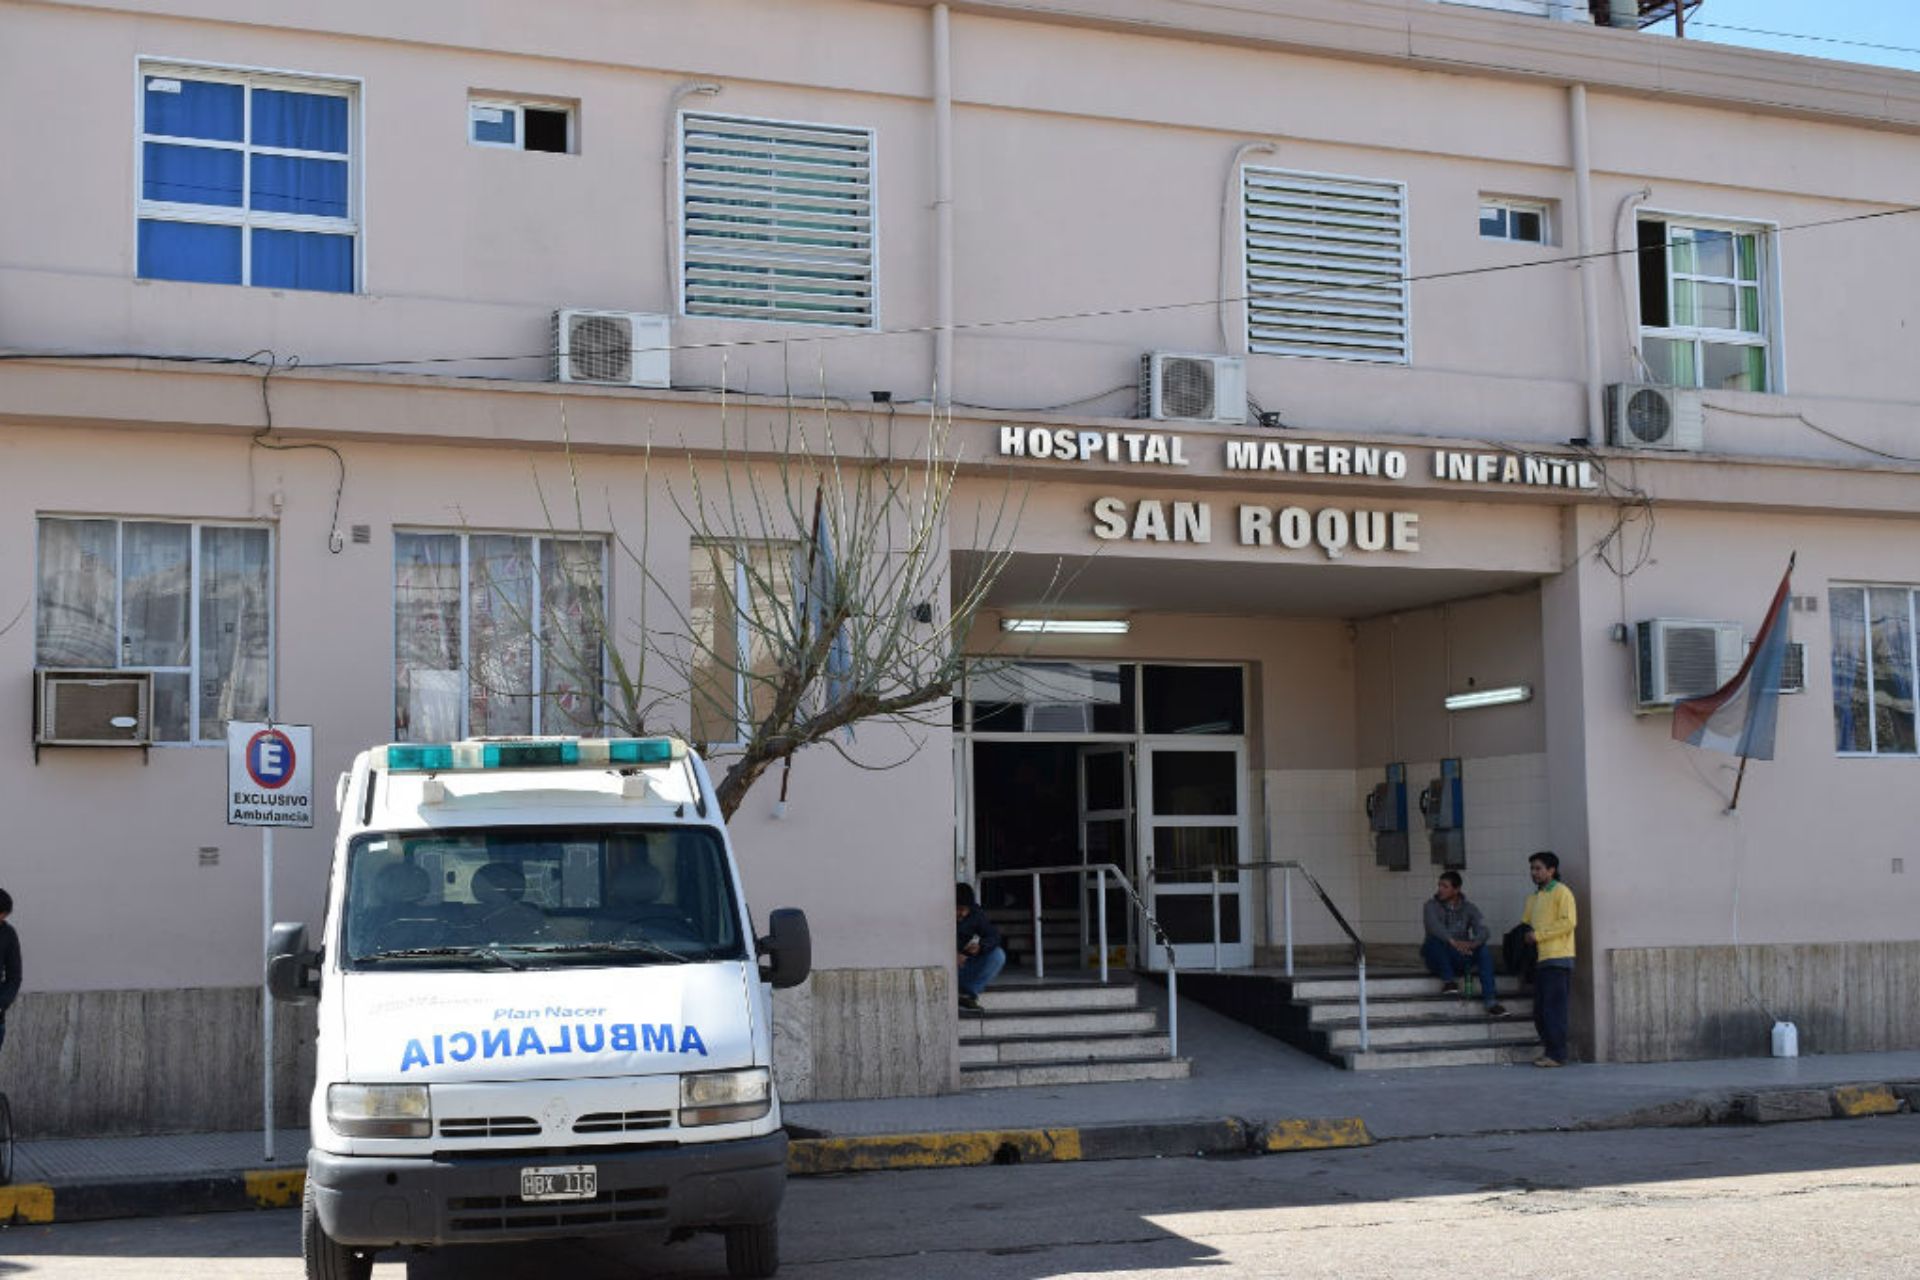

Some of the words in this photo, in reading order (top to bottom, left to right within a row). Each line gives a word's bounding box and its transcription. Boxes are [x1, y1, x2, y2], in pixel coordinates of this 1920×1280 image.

[1000, 426, 1190, 466] HOSPITAL
[1226, 440, 1407, 479] MATERNO
[1435, 450, 1598, 488] INFANTIL
[1094, 497, 1211, 543] SAN
[1239, 504, 1420, 559] ROQUE
[260, 743, 283, 776] E
[234, 792, 308, 806] EXCLUSIVO
[234, 809, 309, 822] Ambulancia
[493, 1007, 541, 1020] Plan
[544, 1006, 607, 1018] Nacer
[523, 1175, 555, 1195] HBX
[565, 1173, 594, 1193] 116
